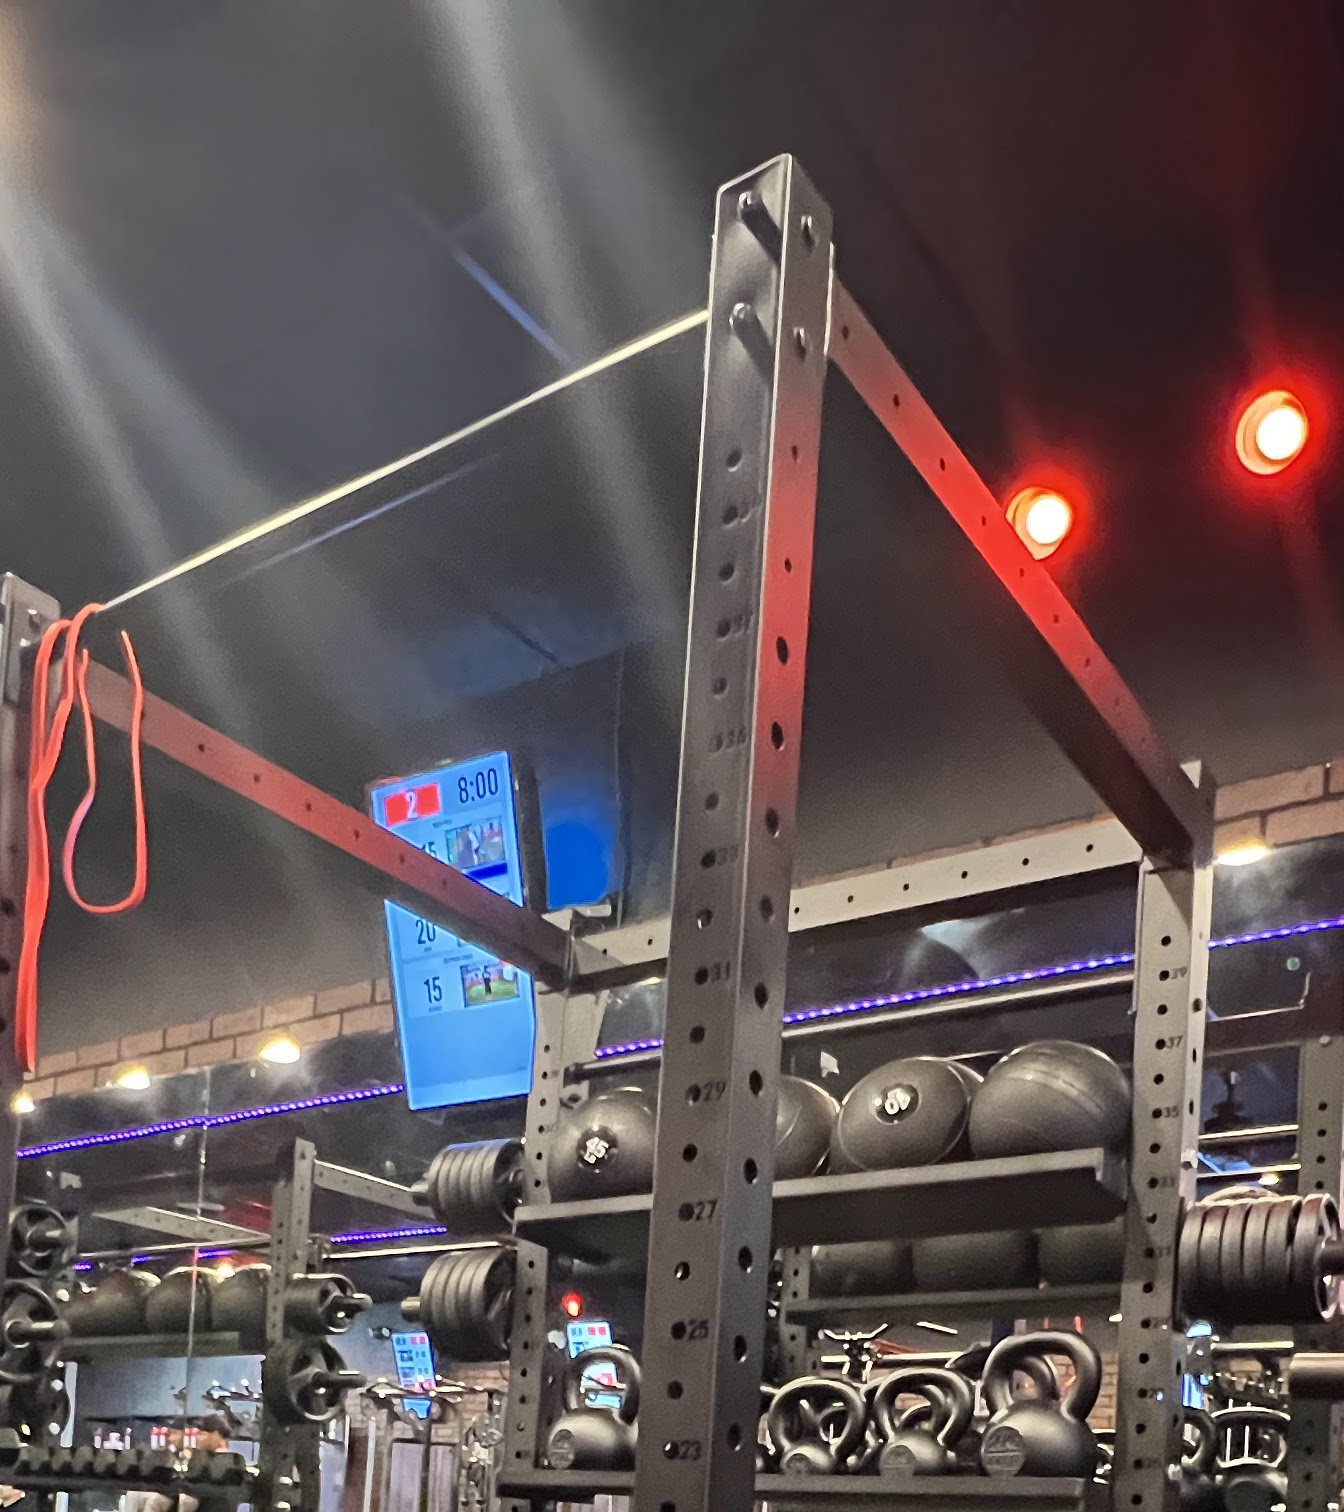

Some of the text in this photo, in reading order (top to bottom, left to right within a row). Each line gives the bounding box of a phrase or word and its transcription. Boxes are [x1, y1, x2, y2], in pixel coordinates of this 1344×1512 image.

[458, 767, 499, 804] 8:00
[405, 790, 418, 820] 2
[423, 976, 443, 1004] 15
[703, 1081, 726, 1101] 29
[1163, 1104, 1180, 1118] 35
[695, 1199, 718, 1222] 27
[688, 1319, 708, 1341] 25
[679, 1439, 701, 1461] 23
